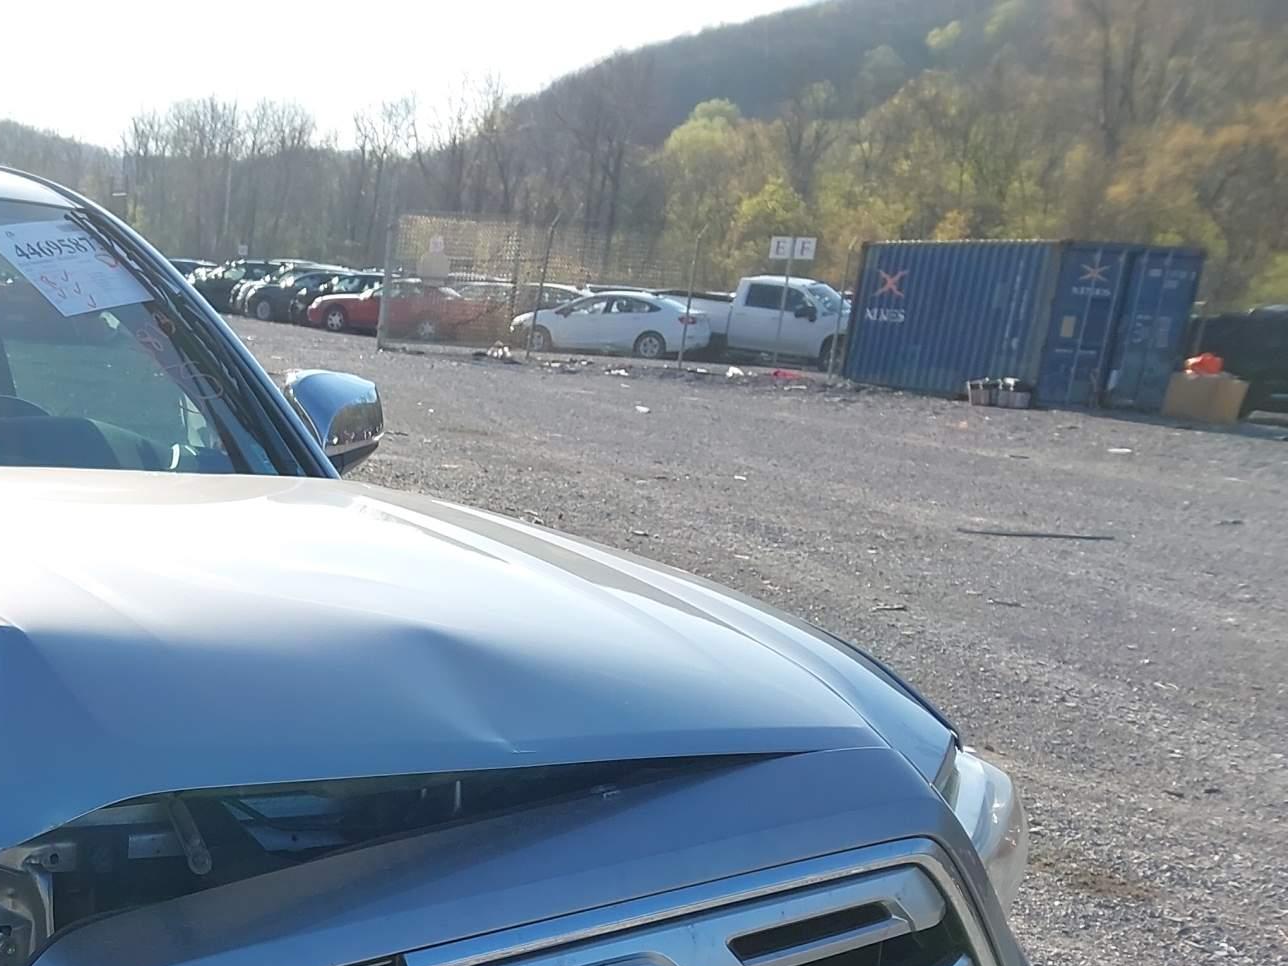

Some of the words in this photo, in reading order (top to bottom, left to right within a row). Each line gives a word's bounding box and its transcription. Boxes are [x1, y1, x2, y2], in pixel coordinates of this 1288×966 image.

[13, 236, 104, 260] 4469587
[775, 240, 787, 256] E
[800, 240, 812, 257] F
